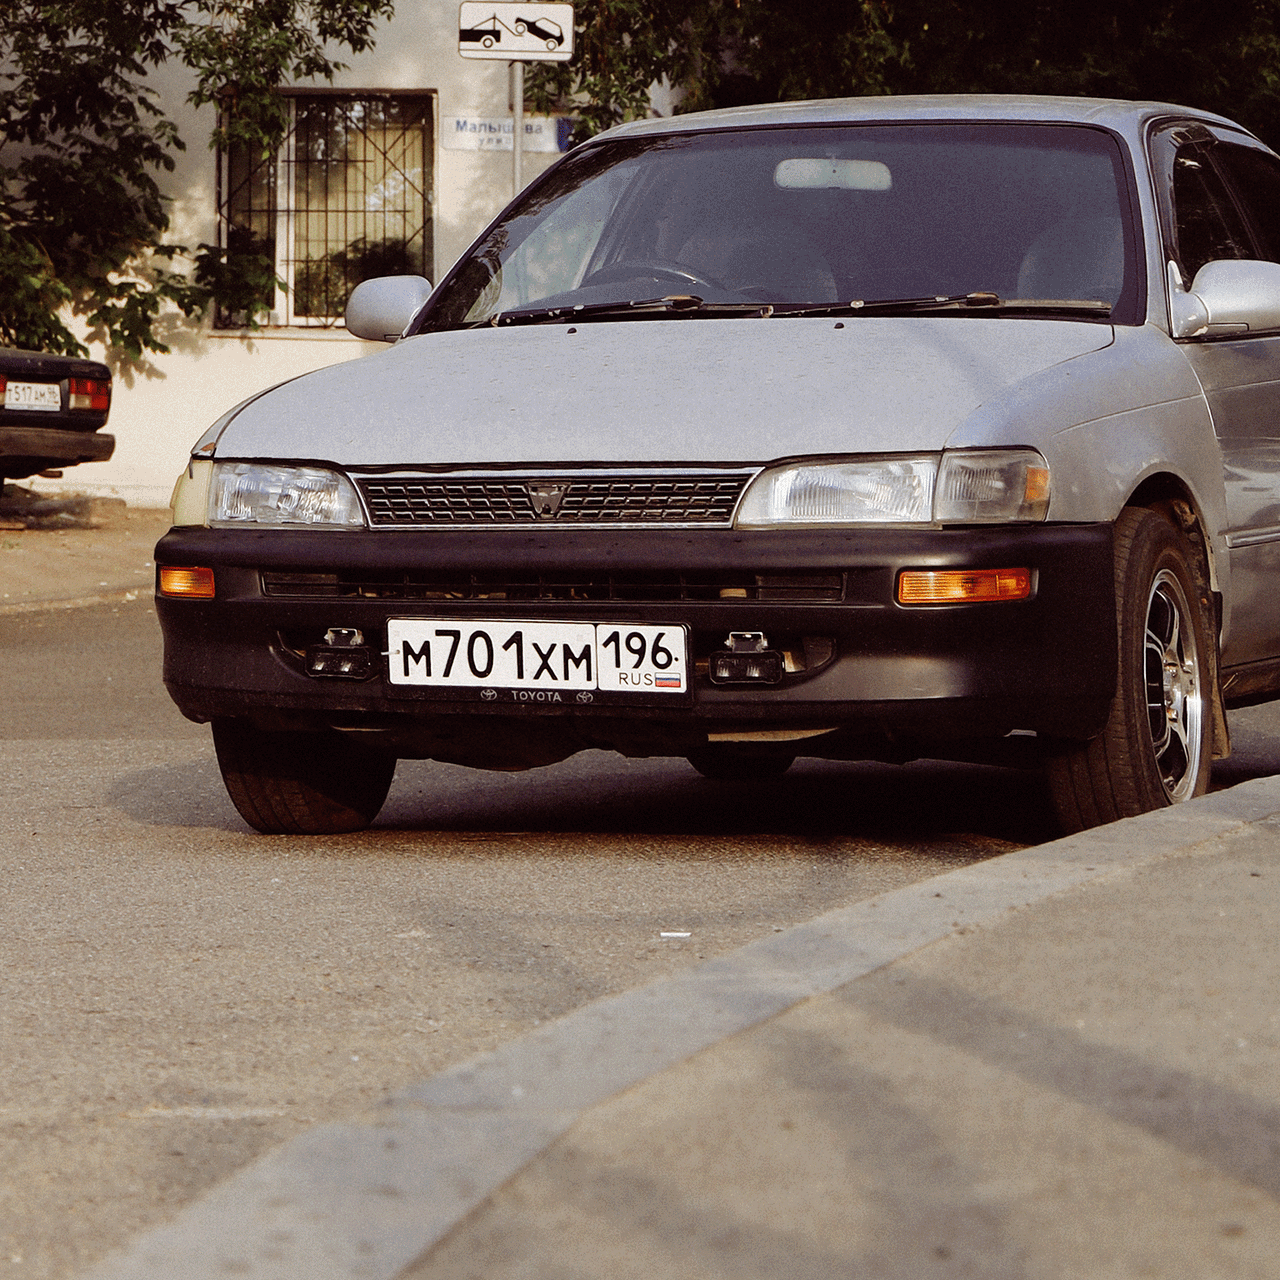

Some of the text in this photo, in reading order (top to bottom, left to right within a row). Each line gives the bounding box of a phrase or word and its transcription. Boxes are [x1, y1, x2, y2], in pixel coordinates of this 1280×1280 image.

[456, 120, 542, 134] Малышва
[602, 630, 674, 670] 196
[618, 671, 654, 687] RUS
[511, 690, 562, 703] TOYOTA
